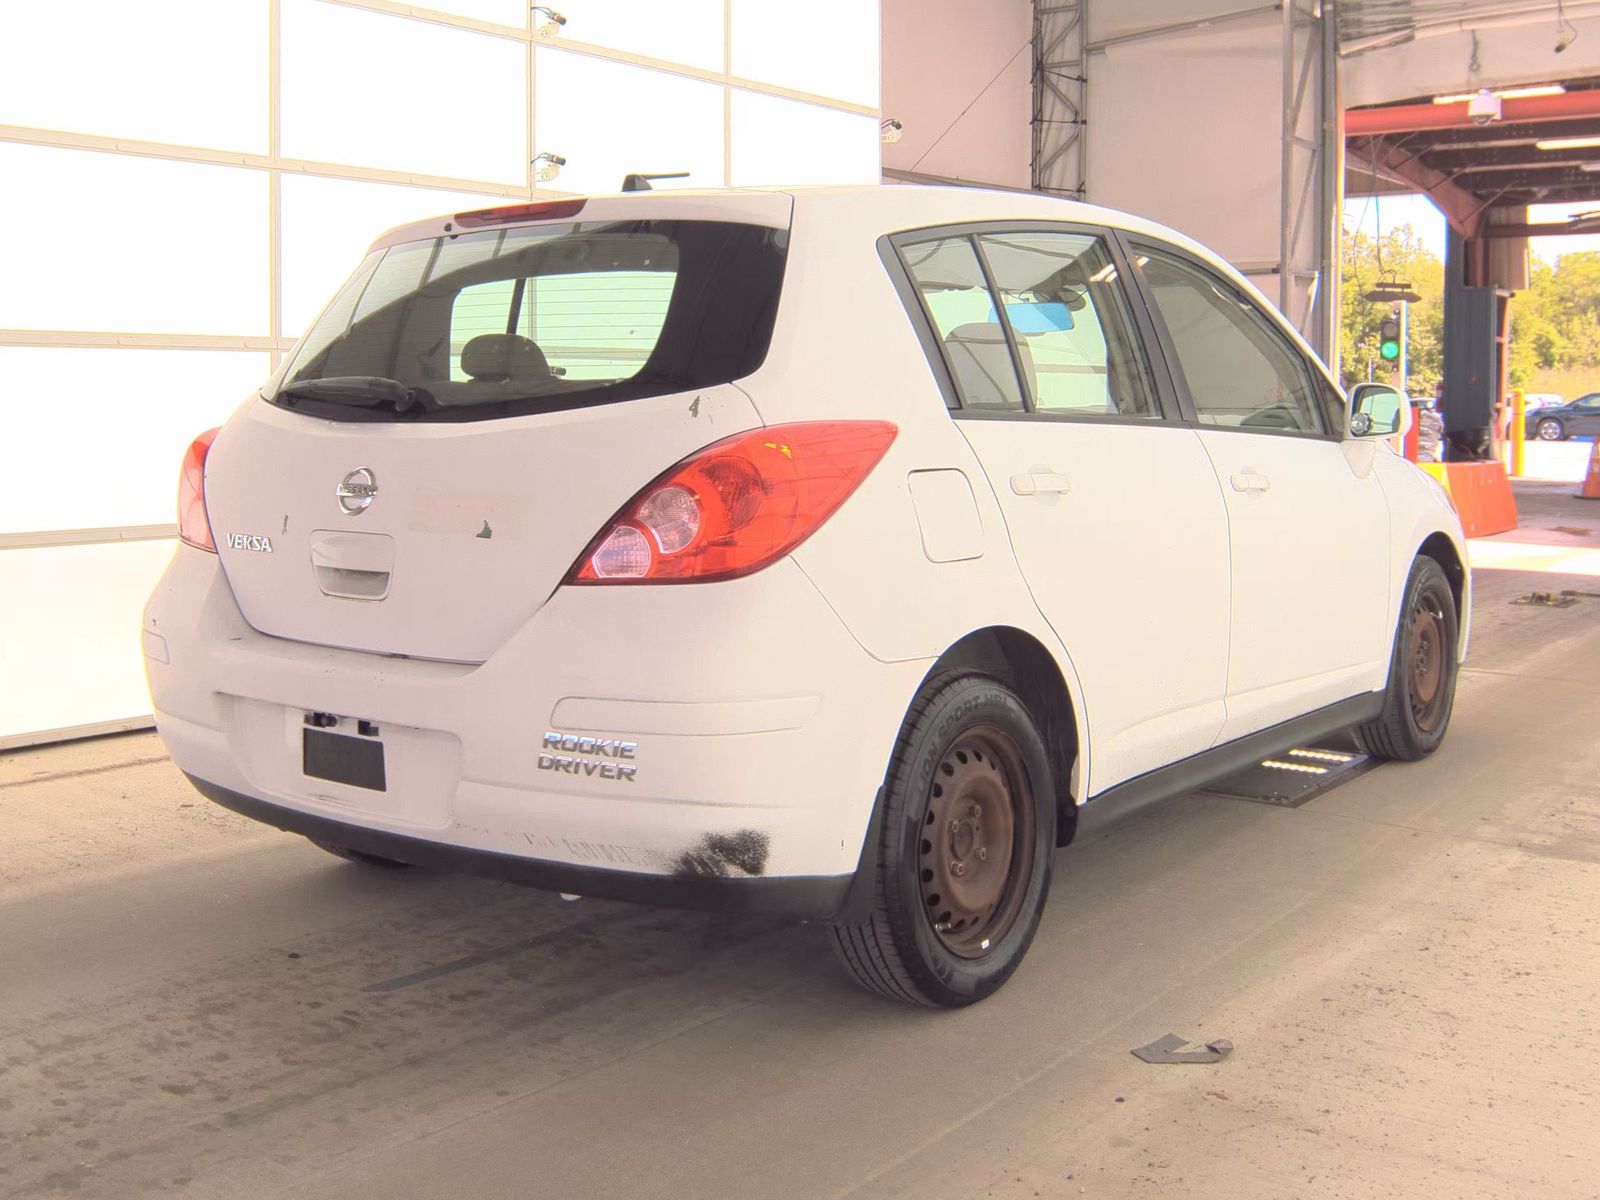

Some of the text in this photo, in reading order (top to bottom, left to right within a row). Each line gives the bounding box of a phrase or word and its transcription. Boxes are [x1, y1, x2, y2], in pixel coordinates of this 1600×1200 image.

[226, 533, 273, 552] VERSA
[543, 731, 639, 759] ROOKIE
[537, 752, 637, 782] DRIVER
